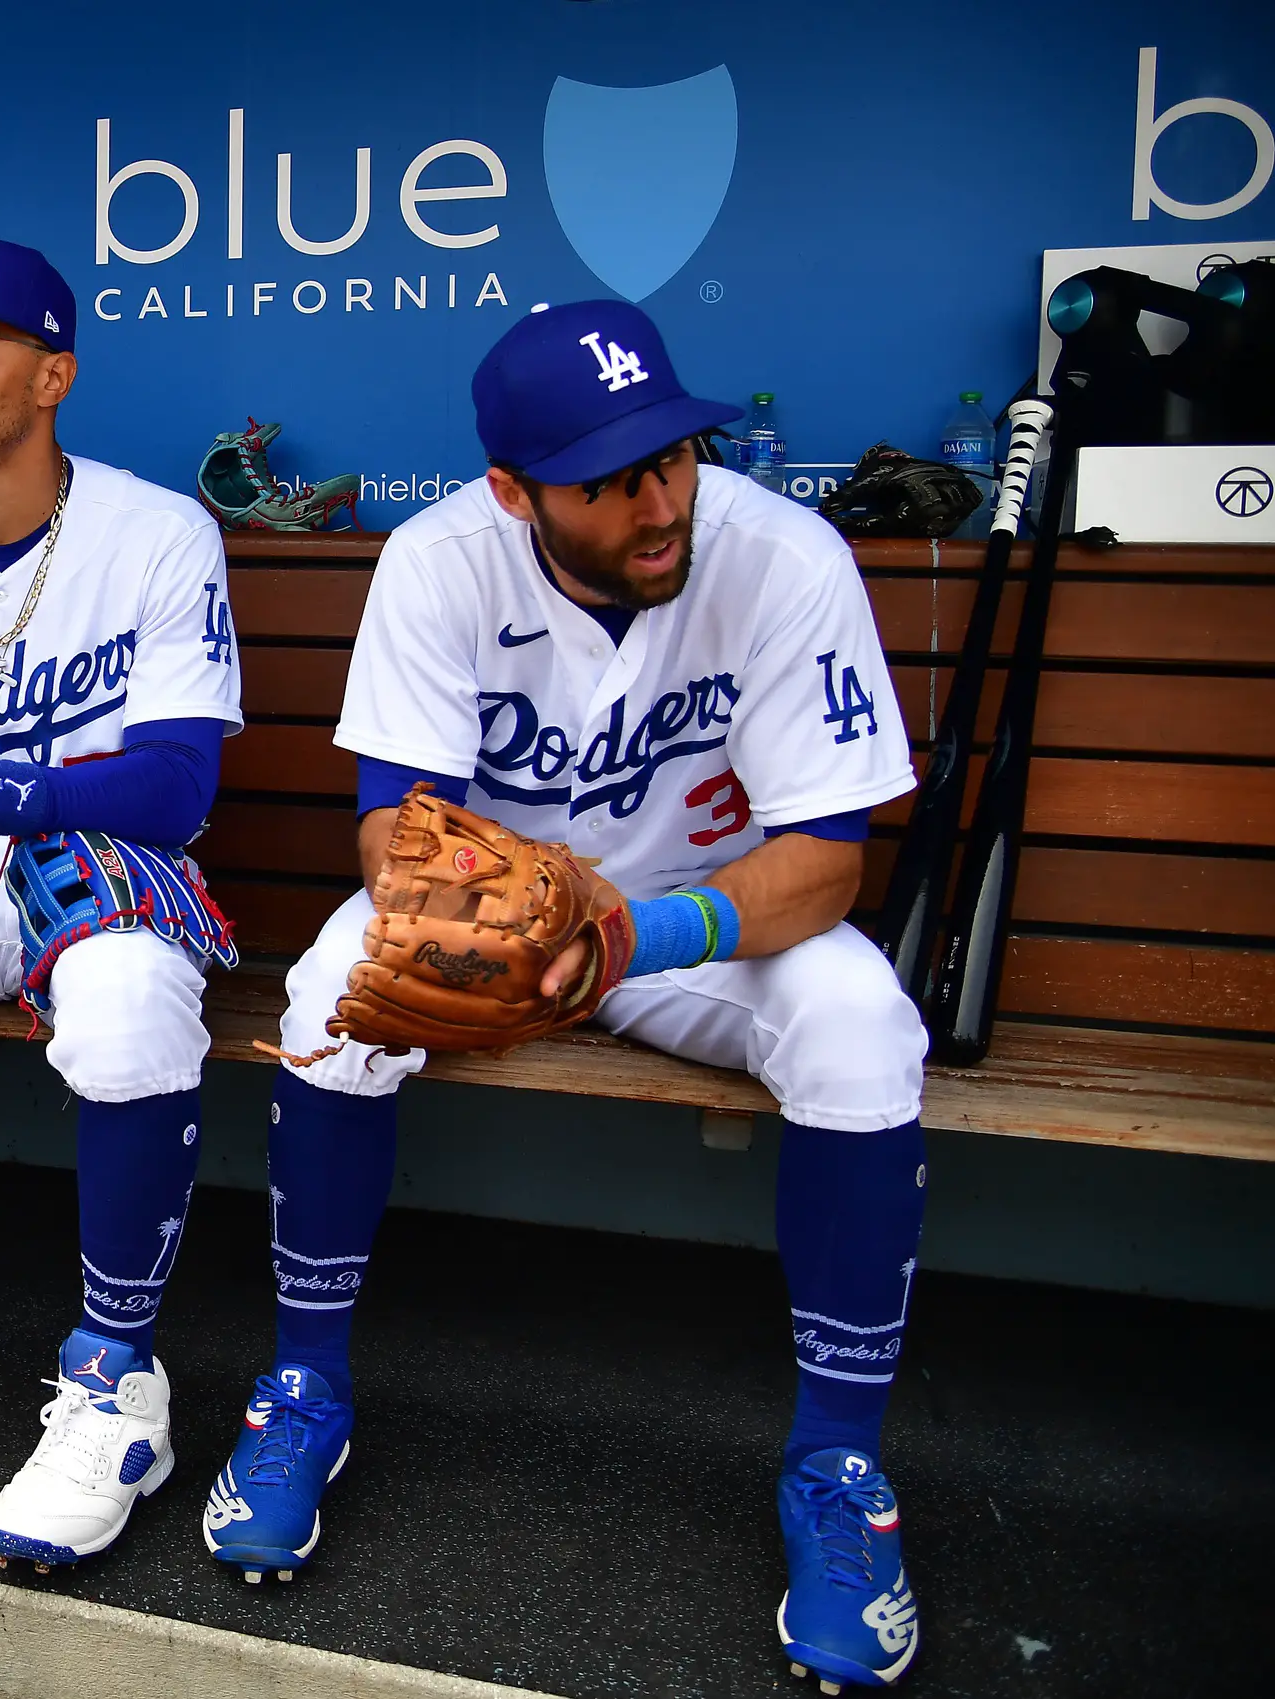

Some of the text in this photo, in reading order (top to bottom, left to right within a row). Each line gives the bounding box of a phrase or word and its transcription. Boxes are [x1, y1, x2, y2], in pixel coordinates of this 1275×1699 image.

[95, 107, 508, 265] blue
[94, 272, 508, 321] CALIFORNIA
[578, 331, 649, 393] LA
[943, 440, 982, 455] DASANI
[816, 649, 878, 745] LA
[477, 671, 742, 820] Dodgers
[685, 767, 752, 848] 3
[96, 848, 127, 881] A2K
[412, 940, 510, 985] Rawlings
[793, 1329, 880, 1362] Angeles
